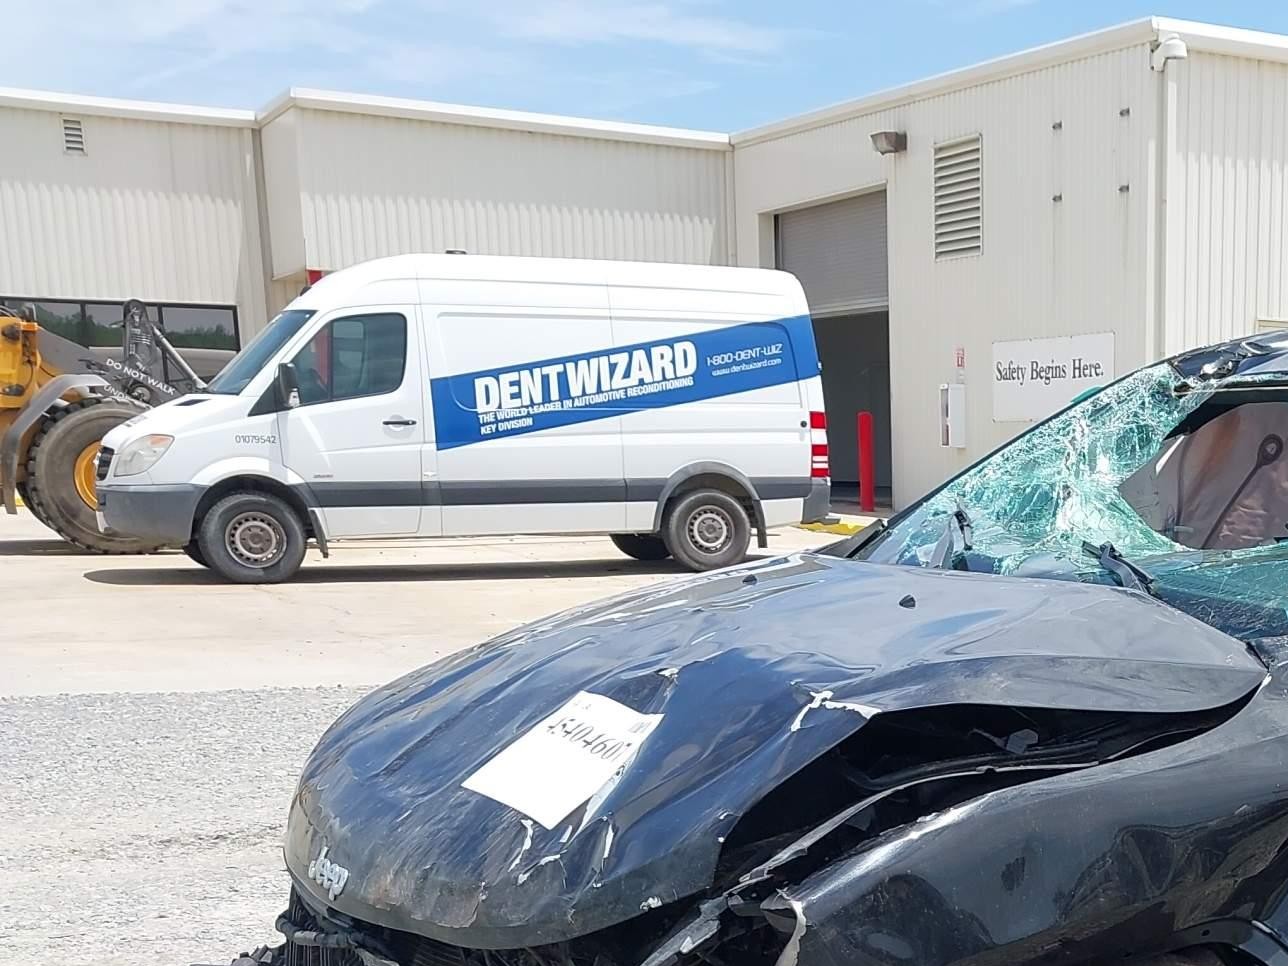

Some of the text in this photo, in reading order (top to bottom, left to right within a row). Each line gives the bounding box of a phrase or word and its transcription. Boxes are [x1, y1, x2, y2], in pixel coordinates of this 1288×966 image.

[706, 343, 783, 367] 1-800-DENT-WIZ
[711, 357, 782, 377] www.dentwizard.com
[106, 358, 122, 370] DO
[123, 366, 146, 380] NOT
[147, 376, 175, 395] WALK
[996, 357, 1104, 386] Safety Begins Here.
[478, 376, 694, 425] THE WORLD LEADER IN AUTOMOTIVE RECONDITIONING
[234, 434, 277, 444] 01079542
[480, 417, 533, 436] KEY DIVISION
[308, 846, 349, 901] Jeep
